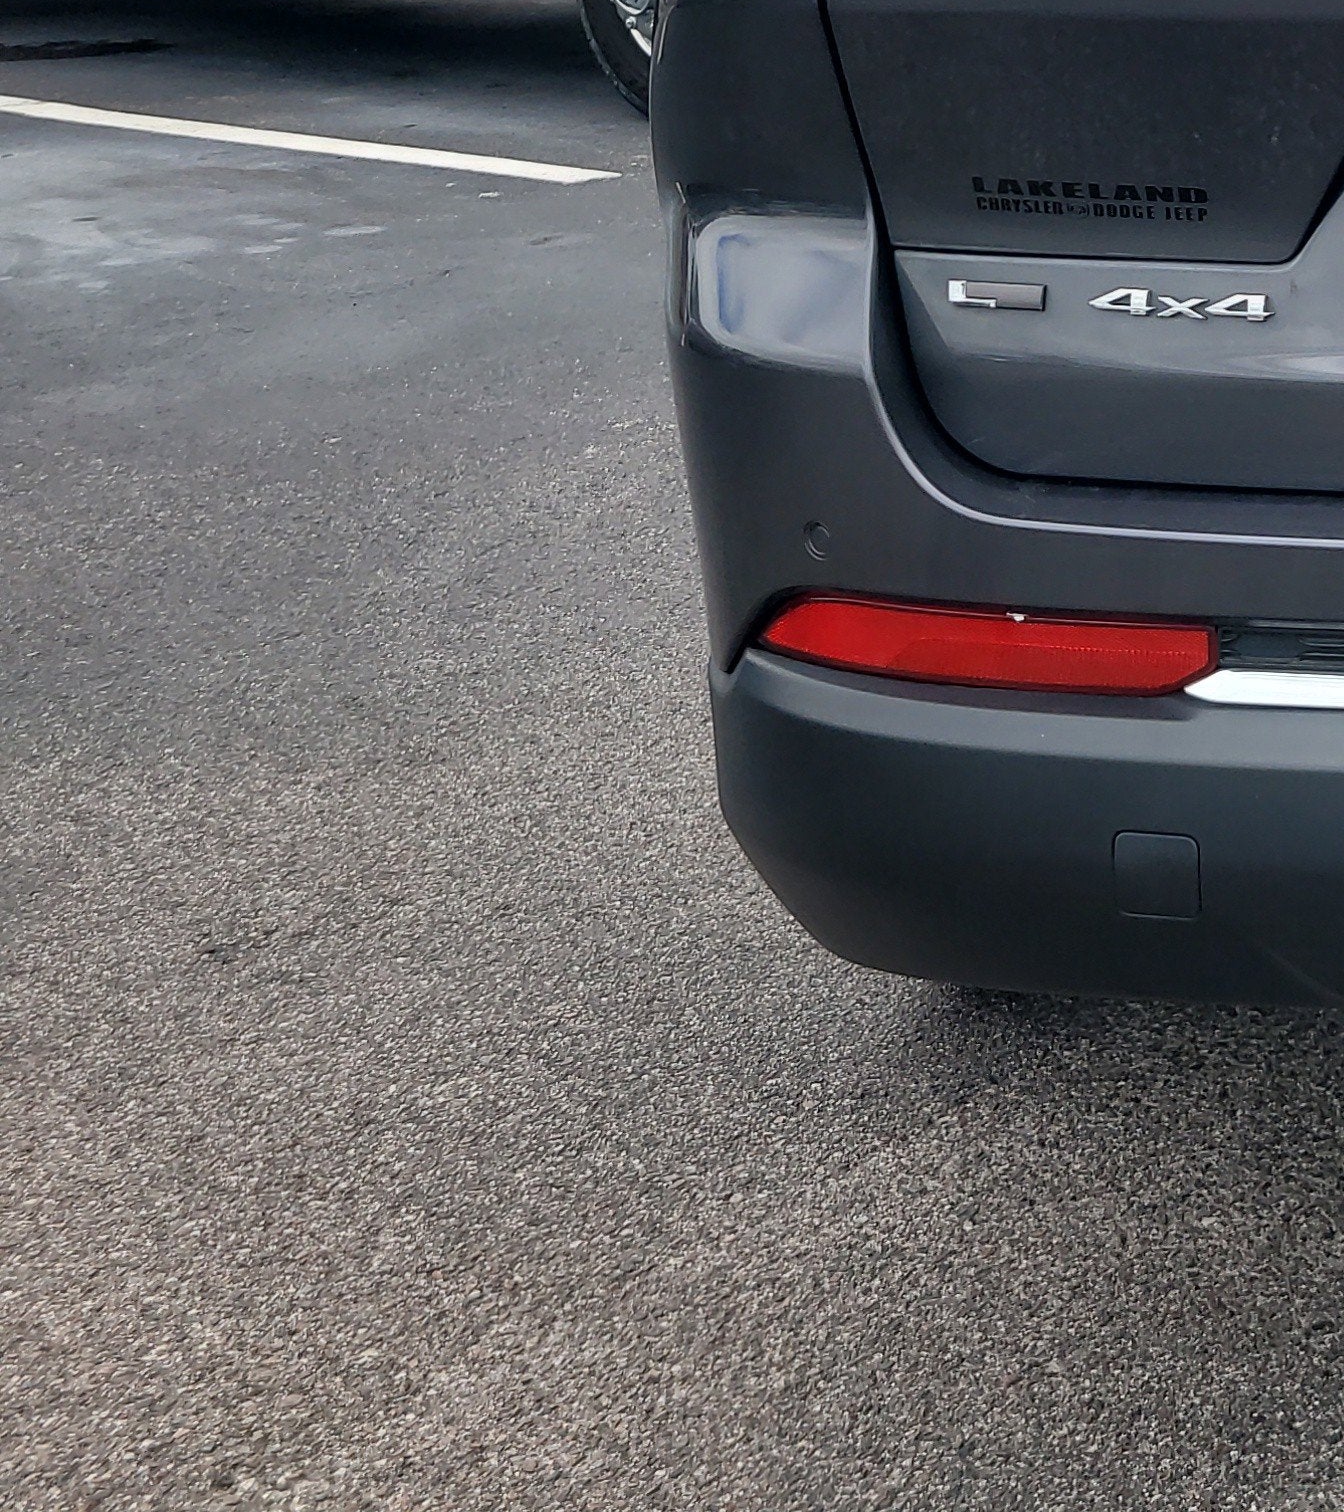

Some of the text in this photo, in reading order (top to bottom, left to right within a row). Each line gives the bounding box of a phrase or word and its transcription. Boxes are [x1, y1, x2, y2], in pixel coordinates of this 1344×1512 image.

[971, 175, 1209, 204] LAKELAND
[976, 196, 1064, 216] CHRYSLER
[1093, 202, 1155, 221] DODGE
[1087, 287, 1276, 323] 4x4
